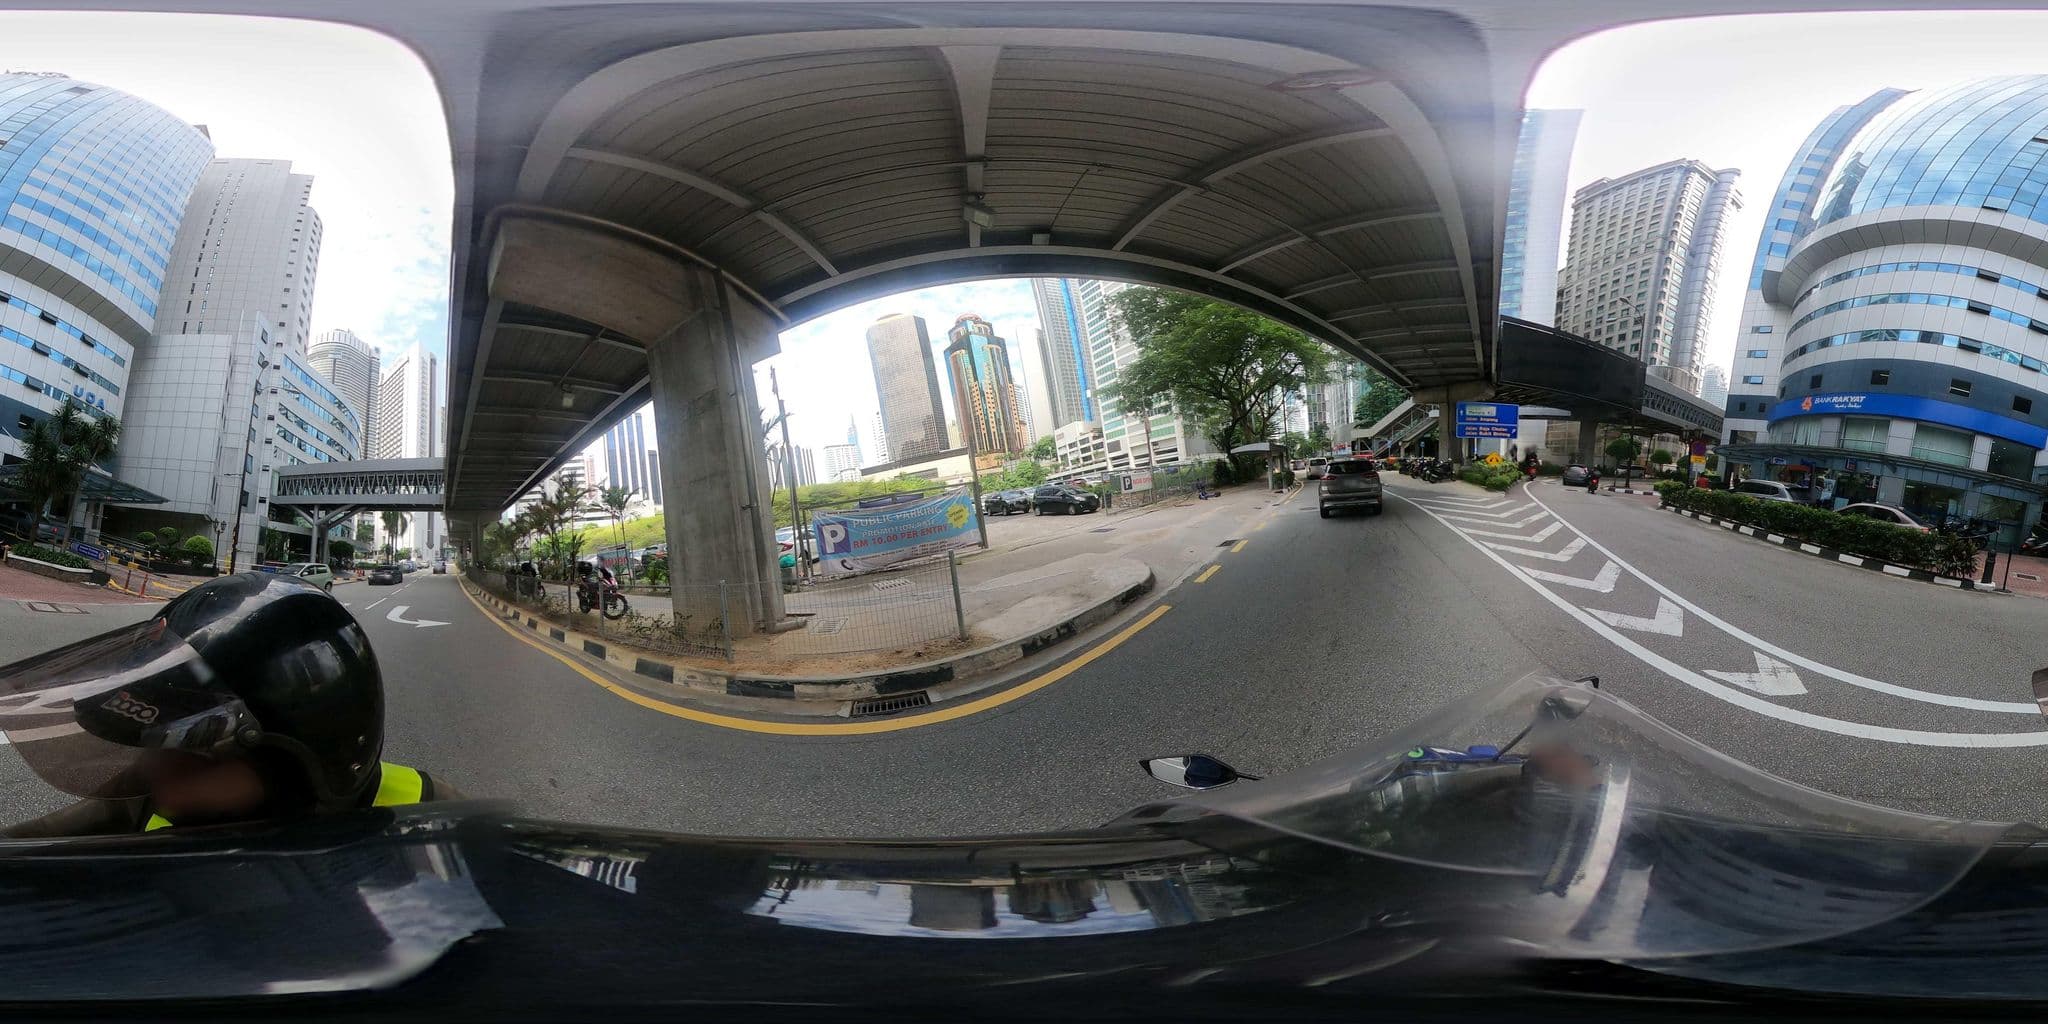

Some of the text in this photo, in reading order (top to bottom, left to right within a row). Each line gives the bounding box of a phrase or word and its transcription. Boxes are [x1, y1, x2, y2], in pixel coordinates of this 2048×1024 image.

[853, 514, 892, 528] PUBLIC
[896, 506, 942, 521] PARKING
[821, 523, 847, 554] P
[853, 524, 948, 549] RM 10.00 PER ENTRY
